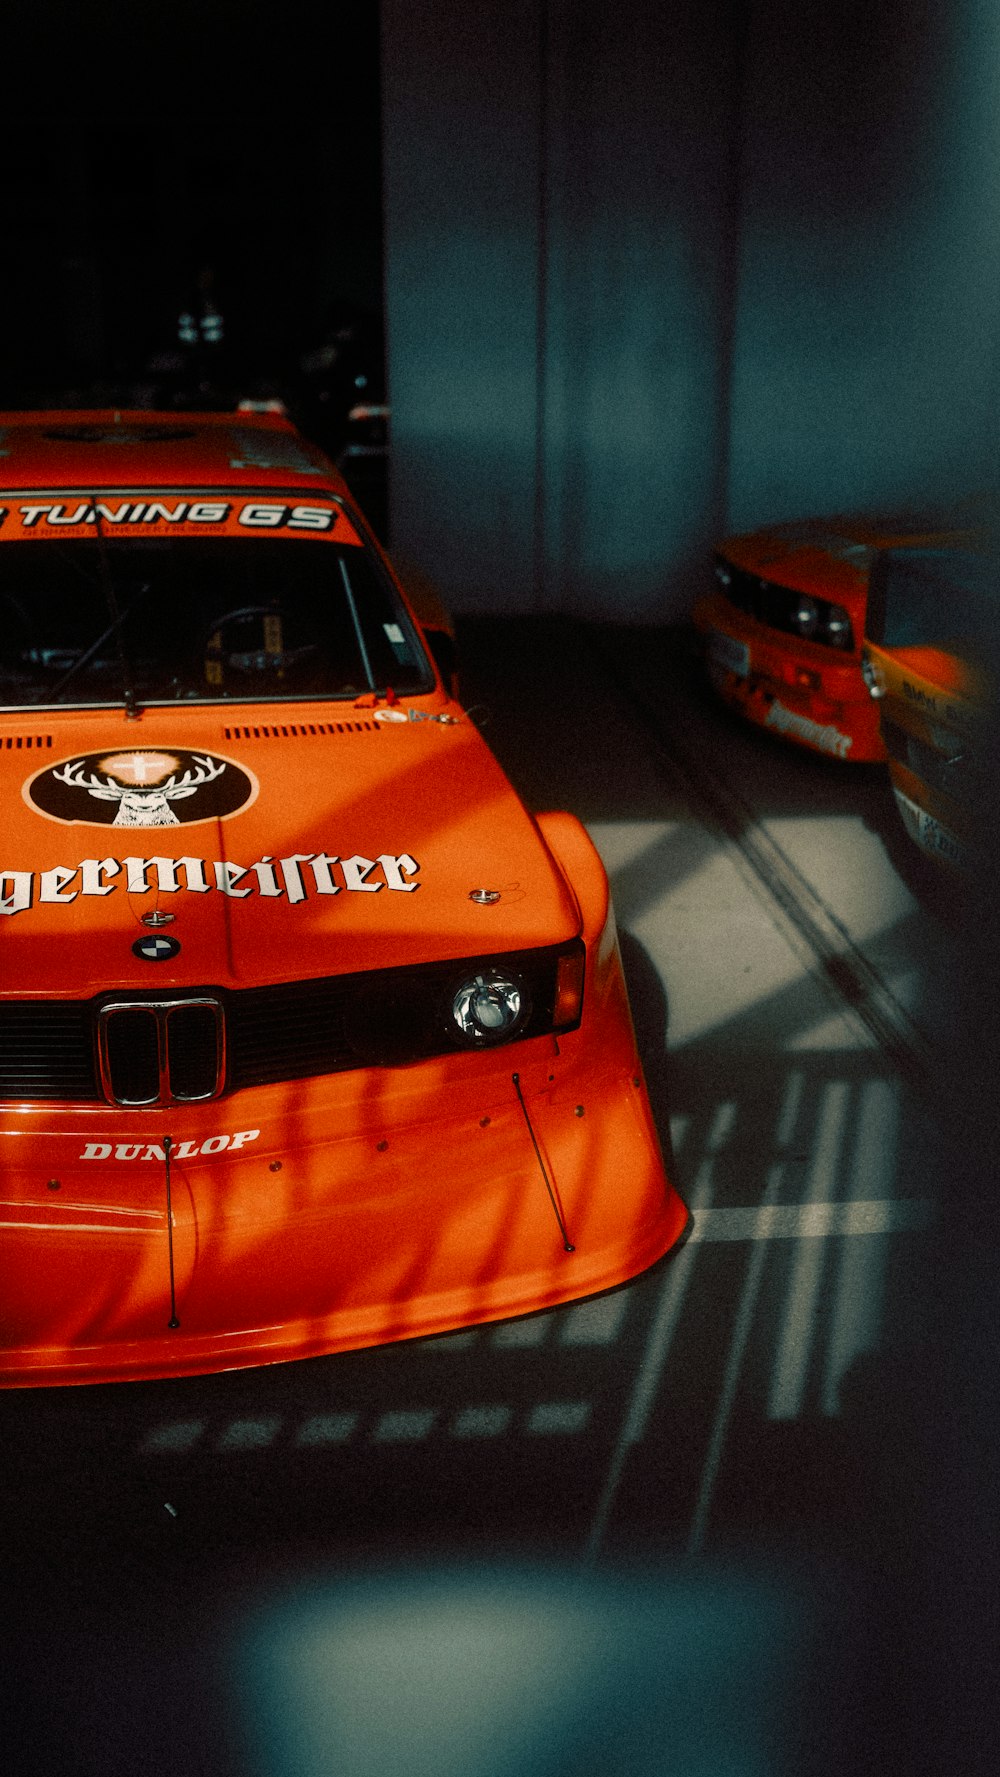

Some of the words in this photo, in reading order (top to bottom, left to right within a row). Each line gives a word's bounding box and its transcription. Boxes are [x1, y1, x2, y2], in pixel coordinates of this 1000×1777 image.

[20, 503, 232, 525] TUNING
[238, 504, 337, 531] GS
[79, 1129, 260, 1160] DUNLOP
